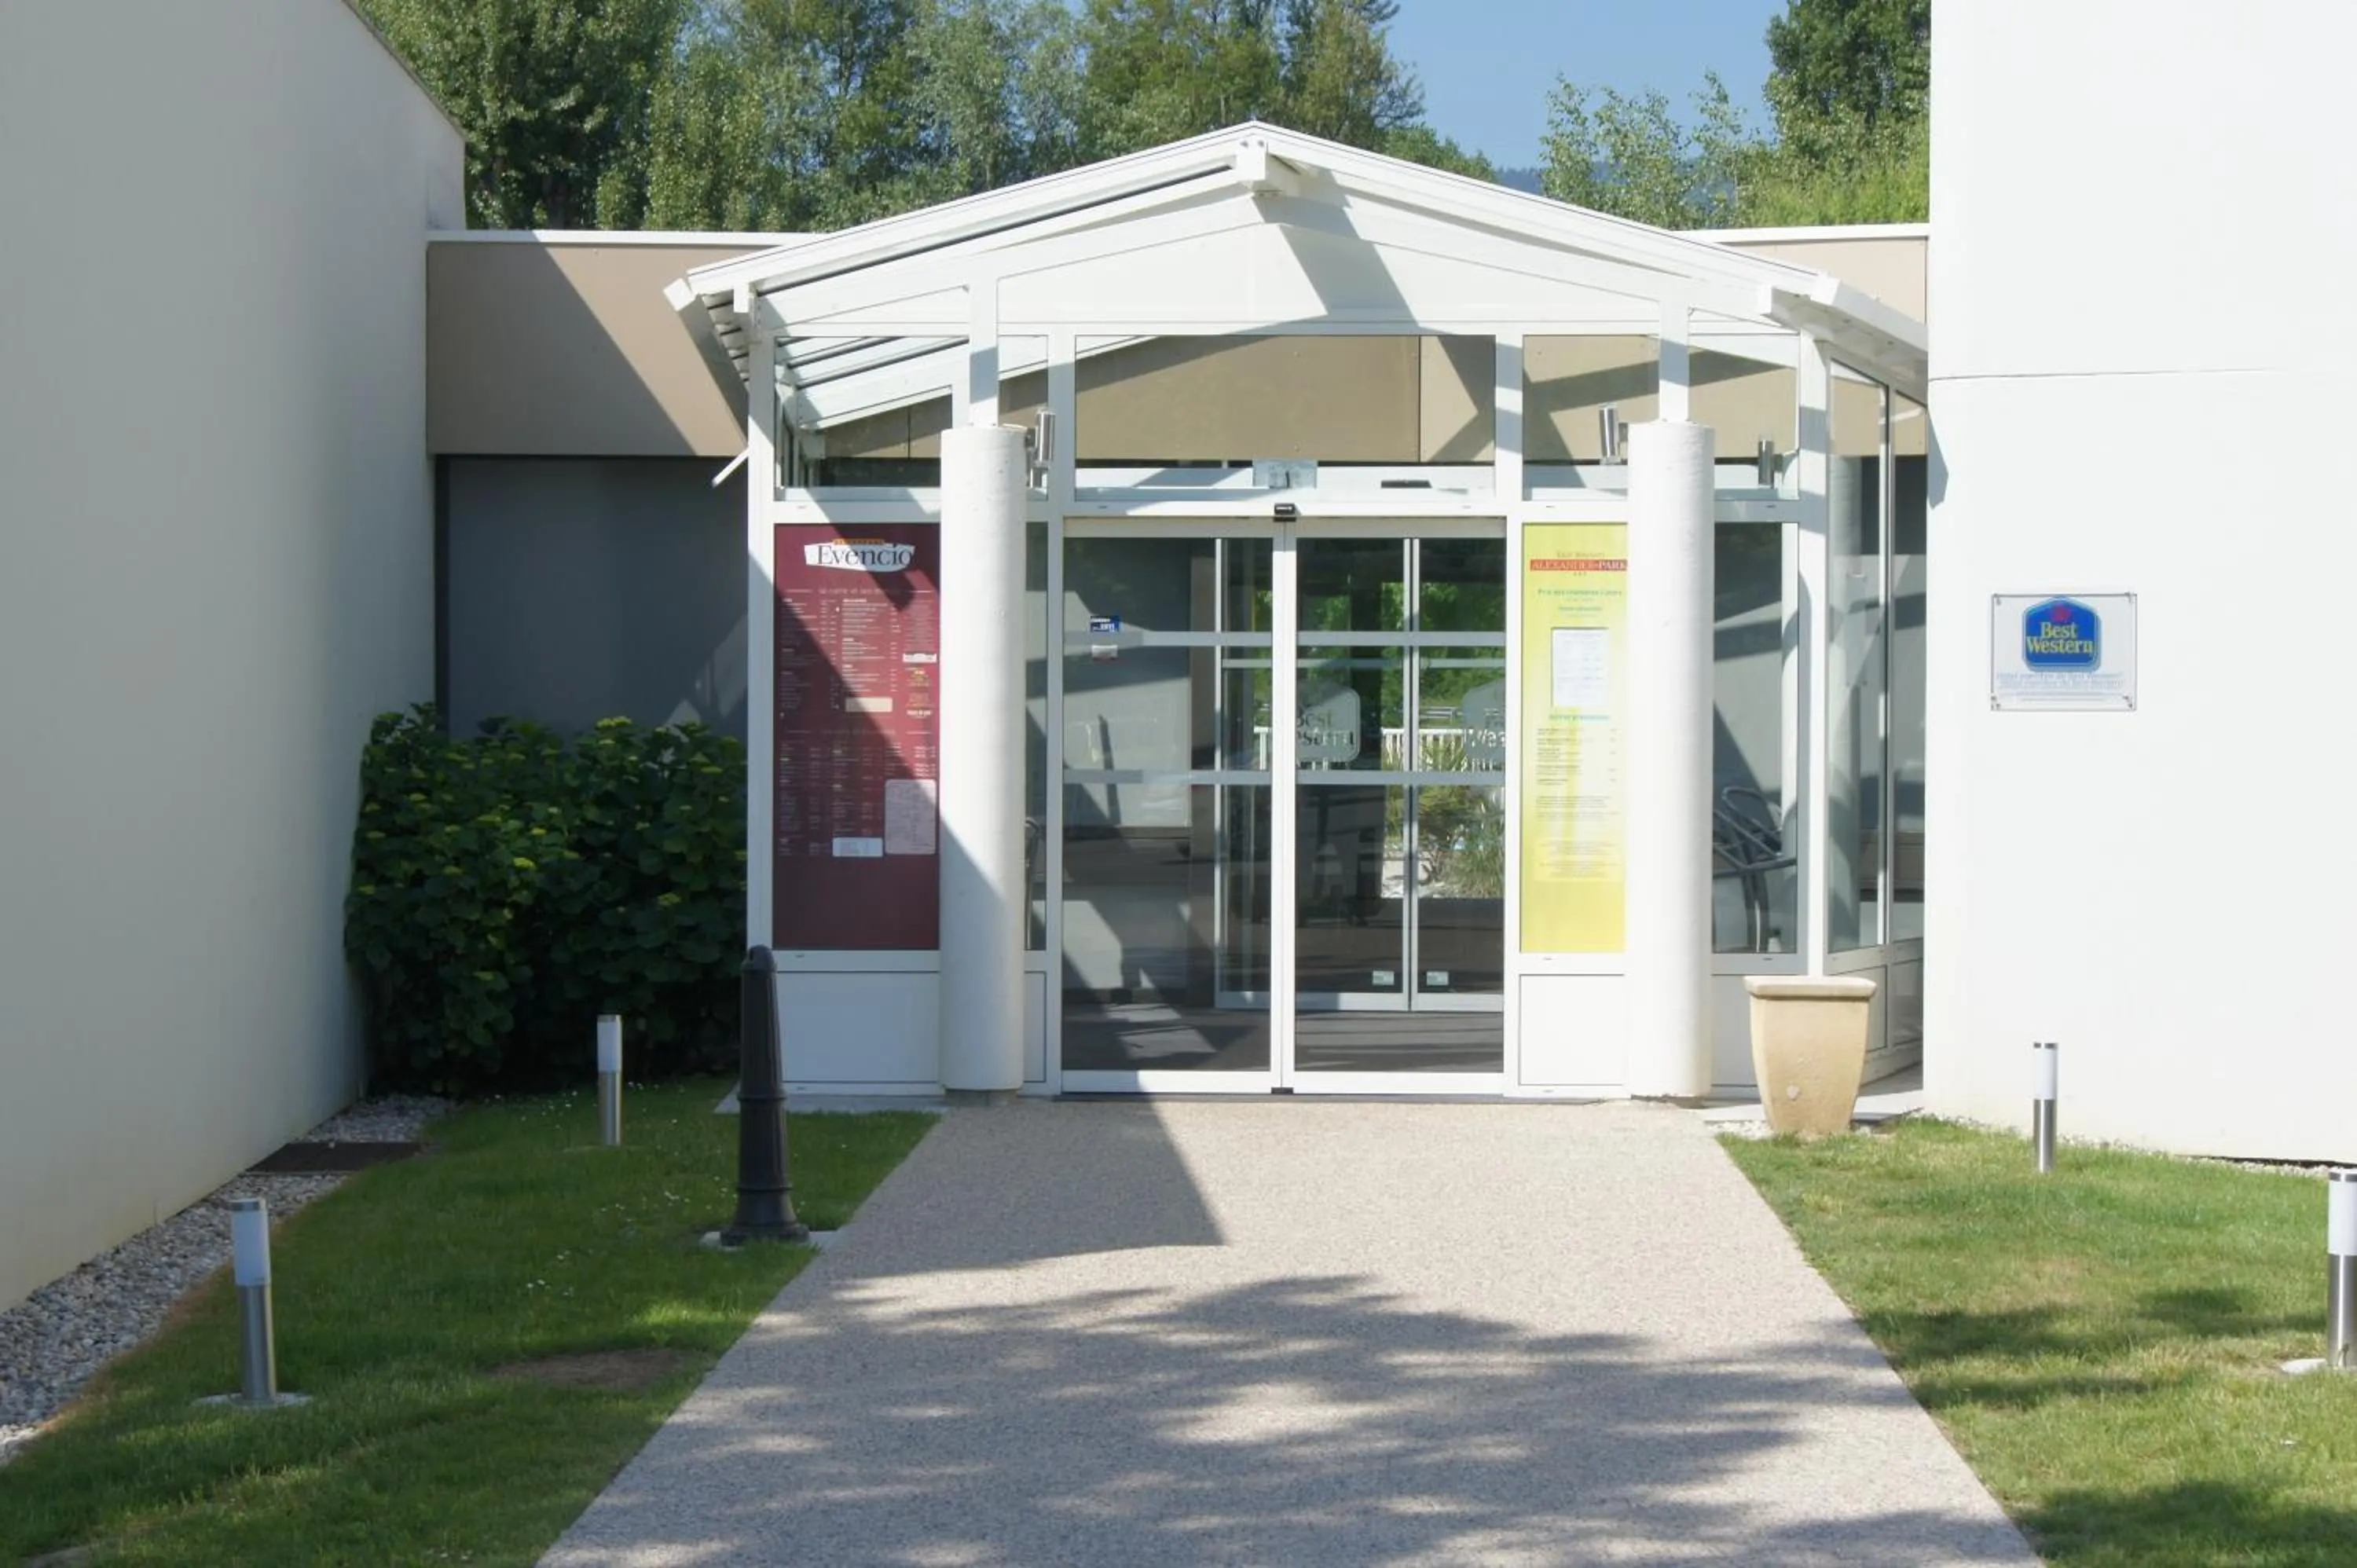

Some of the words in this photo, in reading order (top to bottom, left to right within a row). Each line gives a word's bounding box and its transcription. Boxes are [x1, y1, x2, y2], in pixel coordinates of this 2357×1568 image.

[817, 543, 912, 566] Evencio
[2040, 621, 2077, 639] Best
[2027, 636, 2093, 654] Western
